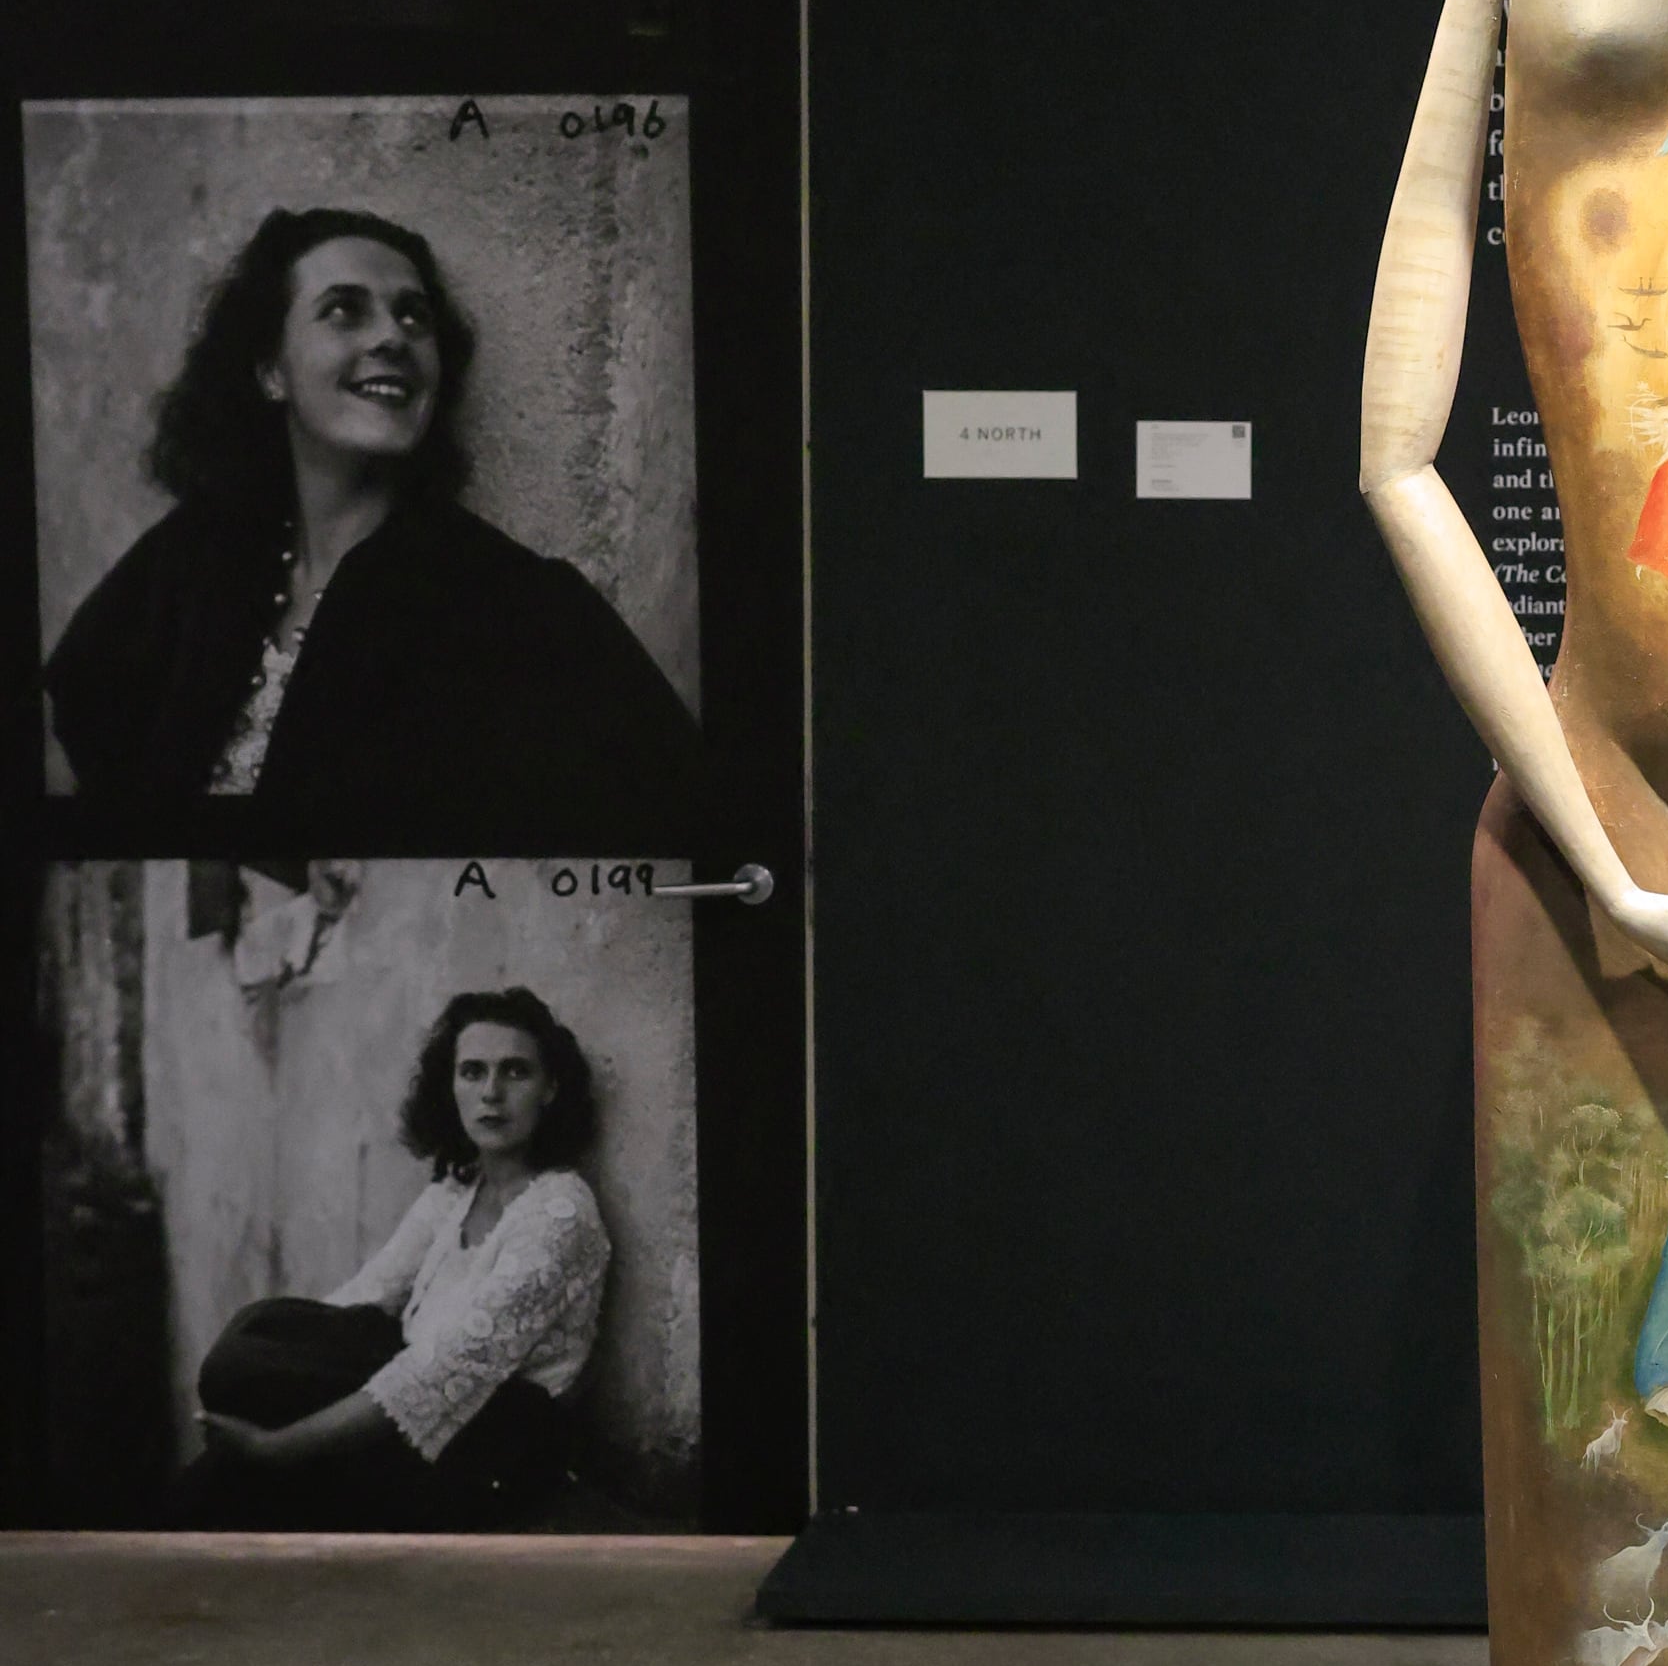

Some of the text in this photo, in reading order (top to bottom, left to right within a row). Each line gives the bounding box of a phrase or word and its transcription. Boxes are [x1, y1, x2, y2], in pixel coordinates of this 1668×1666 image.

[449, 99, 667, 142] A 0196
[977, 426, 1041, 441] NORTH
[1492, 468, 1532, 489] and
[1492, 505, 1533, 520] one
[1510, 594, 1567, 615] diant
[454, 860, 654, 900] A 0199
